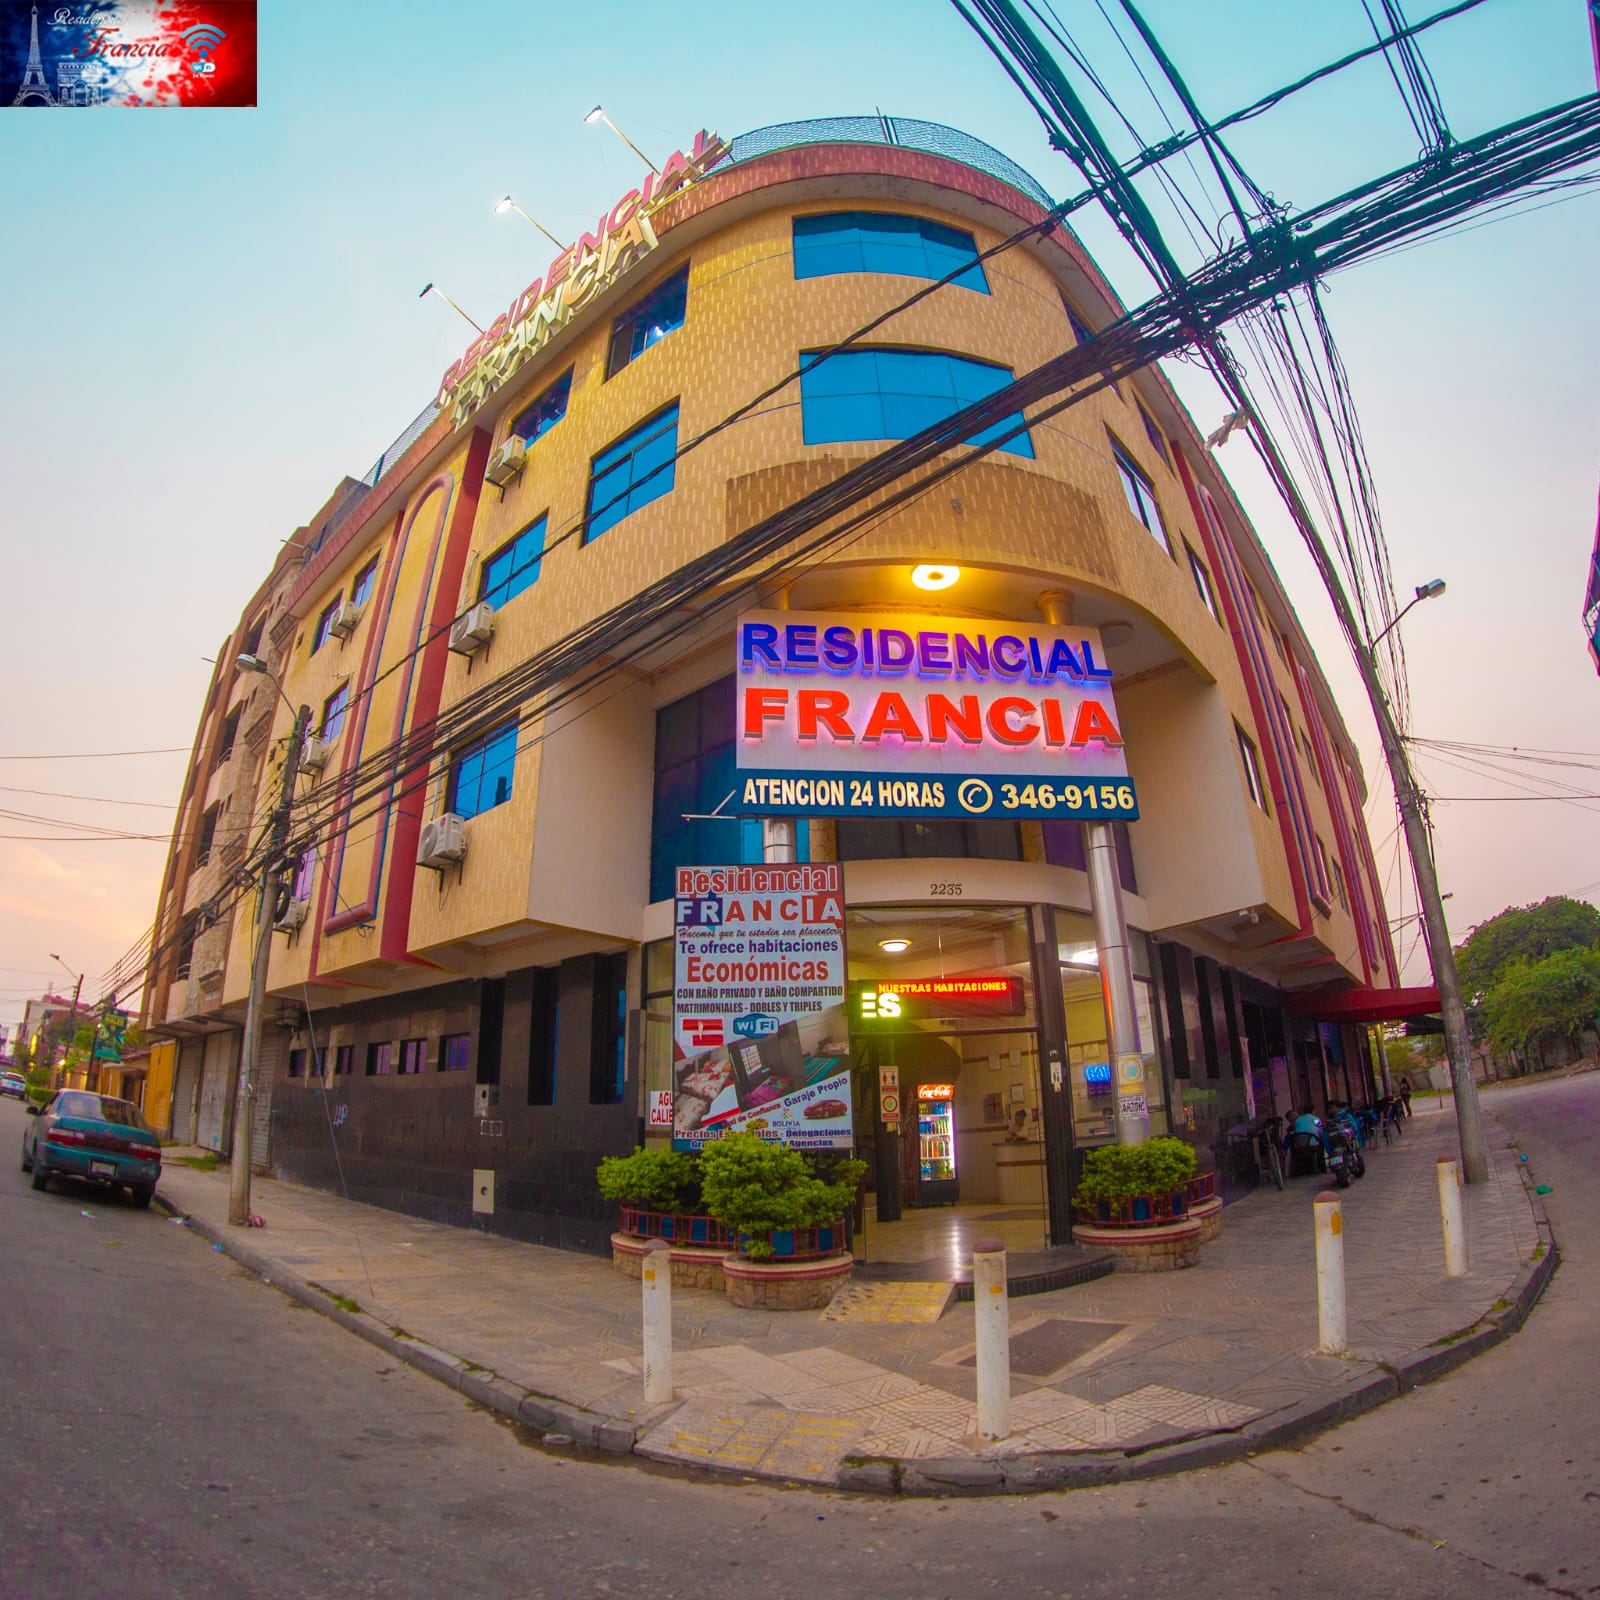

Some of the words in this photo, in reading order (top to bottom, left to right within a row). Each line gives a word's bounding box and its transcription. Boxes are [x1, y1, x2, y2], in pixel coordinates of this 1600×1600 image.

[433, 127, 731, 410] RESIDENCIAL
[451, 212, 659, 433] FRANCIA
[741, 623, 1113, 682] RESIDENCIAL
[744, 687, 1124, 749] FRANCIA
[743, 778, 845, 806] ATENCION
[849, 780, 874, 807] 24
[878, 781, 945, 808] HORAS
[1001, 783, 1134, 811] 346-9156
[677, 866, 839, 894] Residencial
[929, 883, 963, 896] 2235
[676, 898, 843, 923] FRANCIA
[678, 928, 715, 939] Hacemos
[718, 929, 734, 941] que
[736, 929, 746, 938] tu
[781, 929, 796, 937] sea
[799, 926, 843, 940] placentera
[680, 940, 695, 954] Te
[700, 940, 745, 953] ofrece
[749, 938, 839, 952] habitaciones
[687, 955, 829, 983] Económicas
[677, 988, 694, 999] CON
[696, 986, 717, 999] BAÑO
[720, 987, 756, 999] PRIVADO
[758, 988, 764, 998] Y
[765, 986, 787, 998] BAÑO
[789, 986, 843, 997] COMPARTIDO
[878, 984, 931, 993] NUESTRAS
[933, 982, 1007, 992] HABITACIONES
[677, 1002, 743, 1014] MATRIMONIALES
[750, 1002, 782, 1013] DOBLES
[783, 1002, 789, 1012] Y
[790, 1001, 823, 1012] TRIPLES
[784, 1090, 816, 1107] Garaje
[817, 1077, 848, 1095] Propio
[675, 1130, 717, 1139] Precios
[786, 1129, 852, 1139] Delegaciones
[772, 1120, 801, 1128] BOLIVIA
[789, 1138, 834, 1149] Agencias
